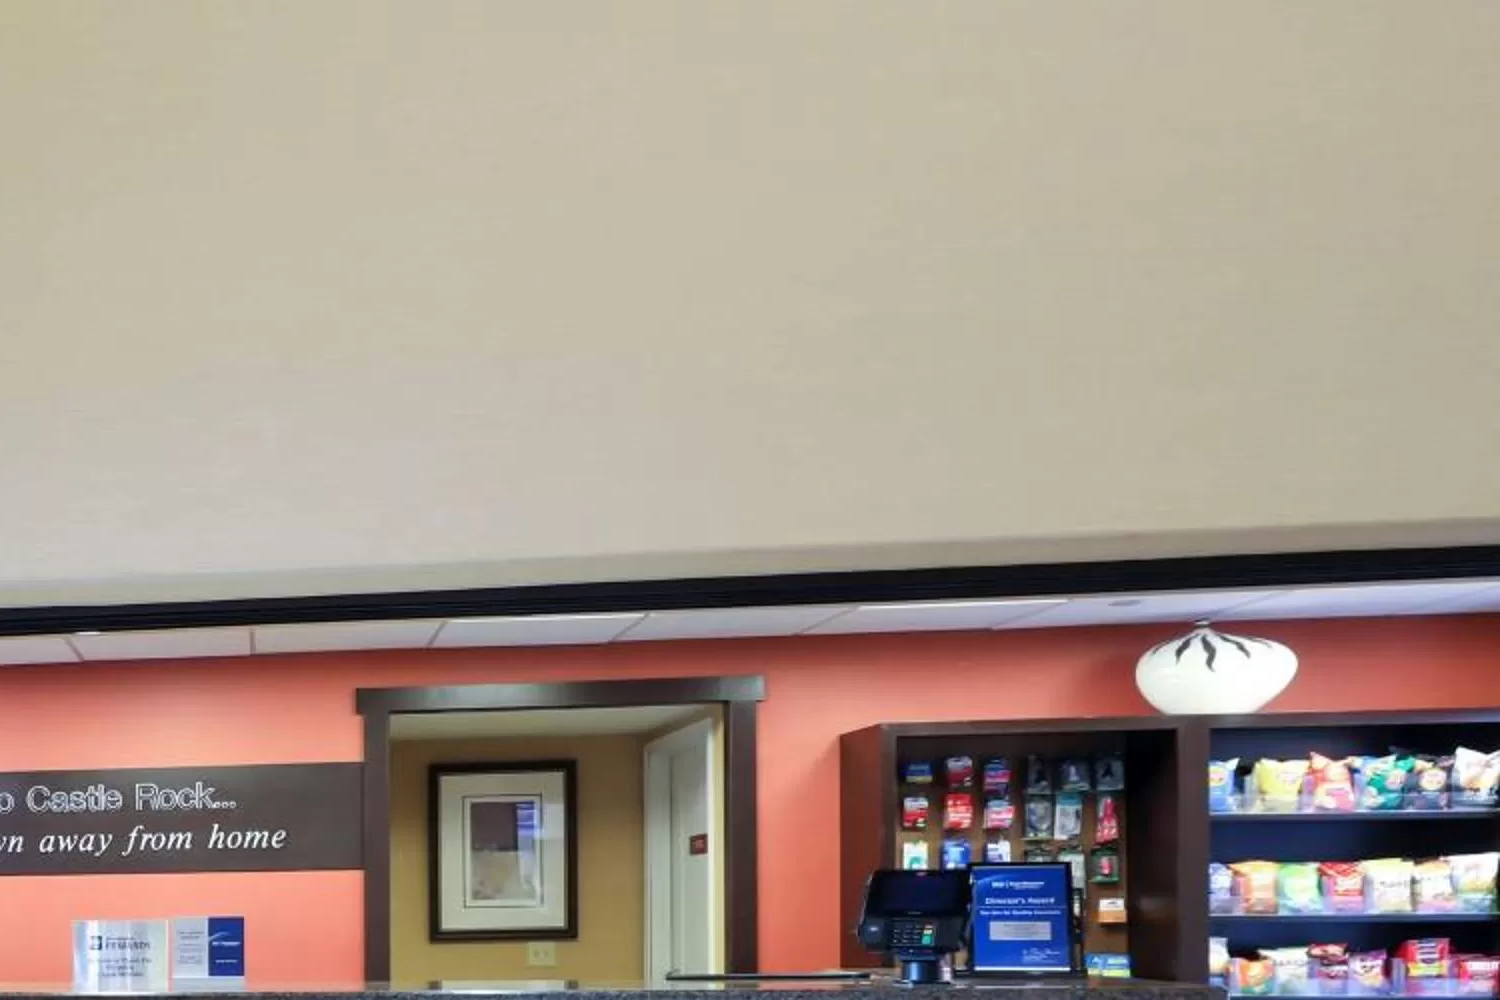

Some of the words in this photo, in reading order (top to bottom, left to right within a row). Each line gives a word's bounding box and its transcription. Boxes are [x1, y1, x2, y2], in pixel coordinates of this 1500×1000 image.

[27, 784, 124, 813] Castle
[39, 832, 113, 857] away
[122, 825, 192, 857] from
[208, 824, 287, 849] home
